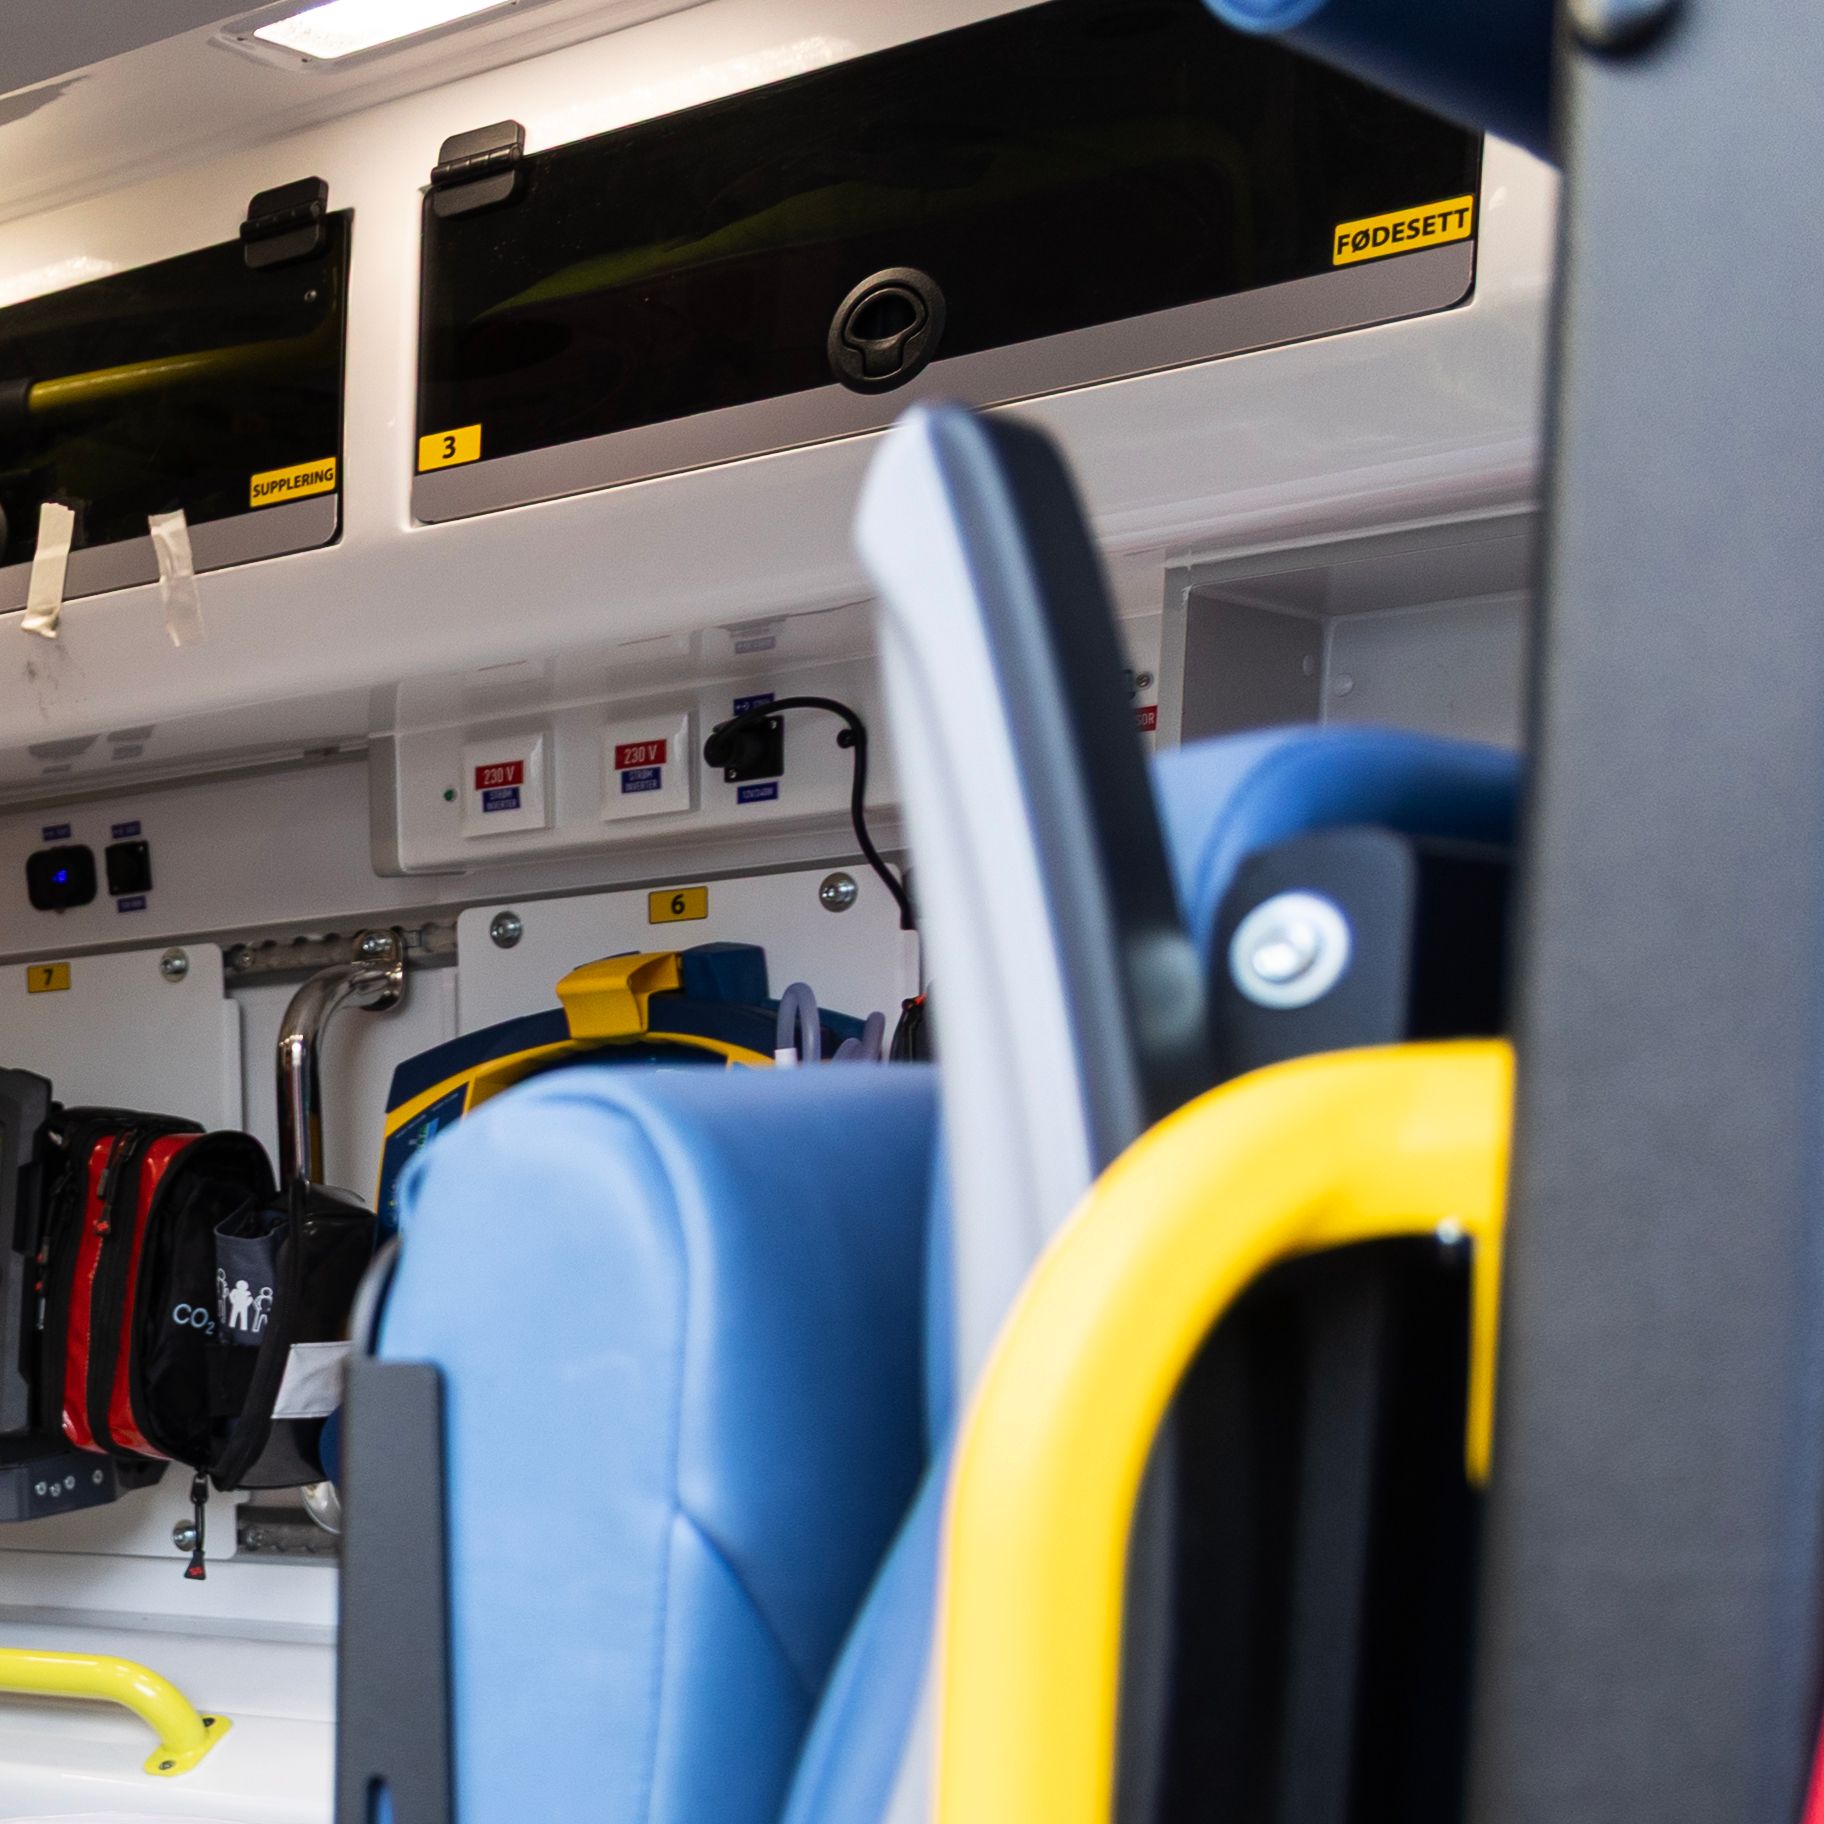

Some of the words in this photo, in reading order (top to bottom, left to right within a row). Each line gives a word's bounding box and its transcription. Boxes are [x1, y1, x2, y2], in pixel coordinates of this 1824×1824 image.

[1336, 206, 1470, 256] FØDESETT
[442, 436, 456, 459] 3
[253, 467, 334, 498] SUPPLERING
[624, 746, 645, 765] 230
[647, 744, 658, 761] V
[484, 768, 503, 785] 230
[507, 766, 516, 782] V
[671, 893, 686, 914] 6
[43, 968, 54, 986] 7
